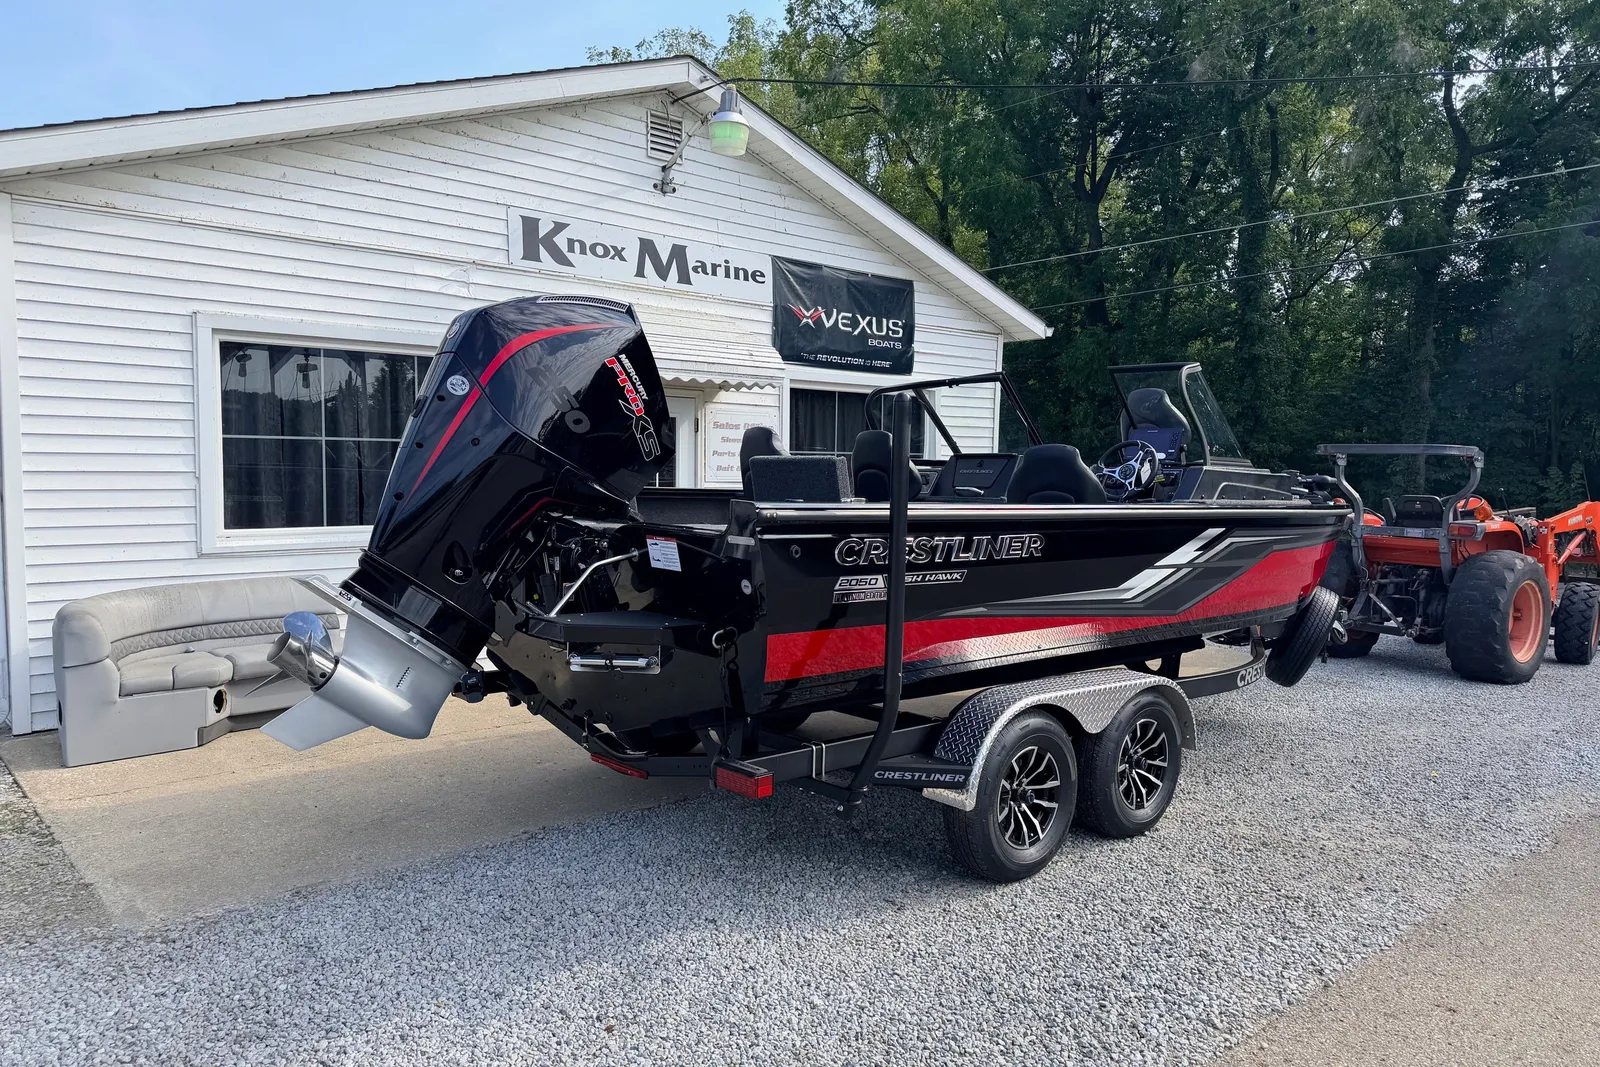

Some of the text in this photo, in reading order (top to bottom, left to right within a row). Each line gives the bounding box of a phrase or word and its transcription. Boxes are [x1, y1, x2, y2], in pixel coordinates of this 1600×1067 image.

[519, 214, 767, 286] Knox Marine
[817, 306, 904, 338] VEXUS
[868, 338, 903, 350] BOATS
[816, 354, 865, 366] REVOLUTION
[618, 353, 649, 401] MERCURY
[604, 356, 645, 417] PRO
[716, 464, 735, 472] Bait
[838, 577, 879, 587] 2050
[925, 572, 962, 582] HAWK
[874, 770, 966, 783] CRESTLINER
